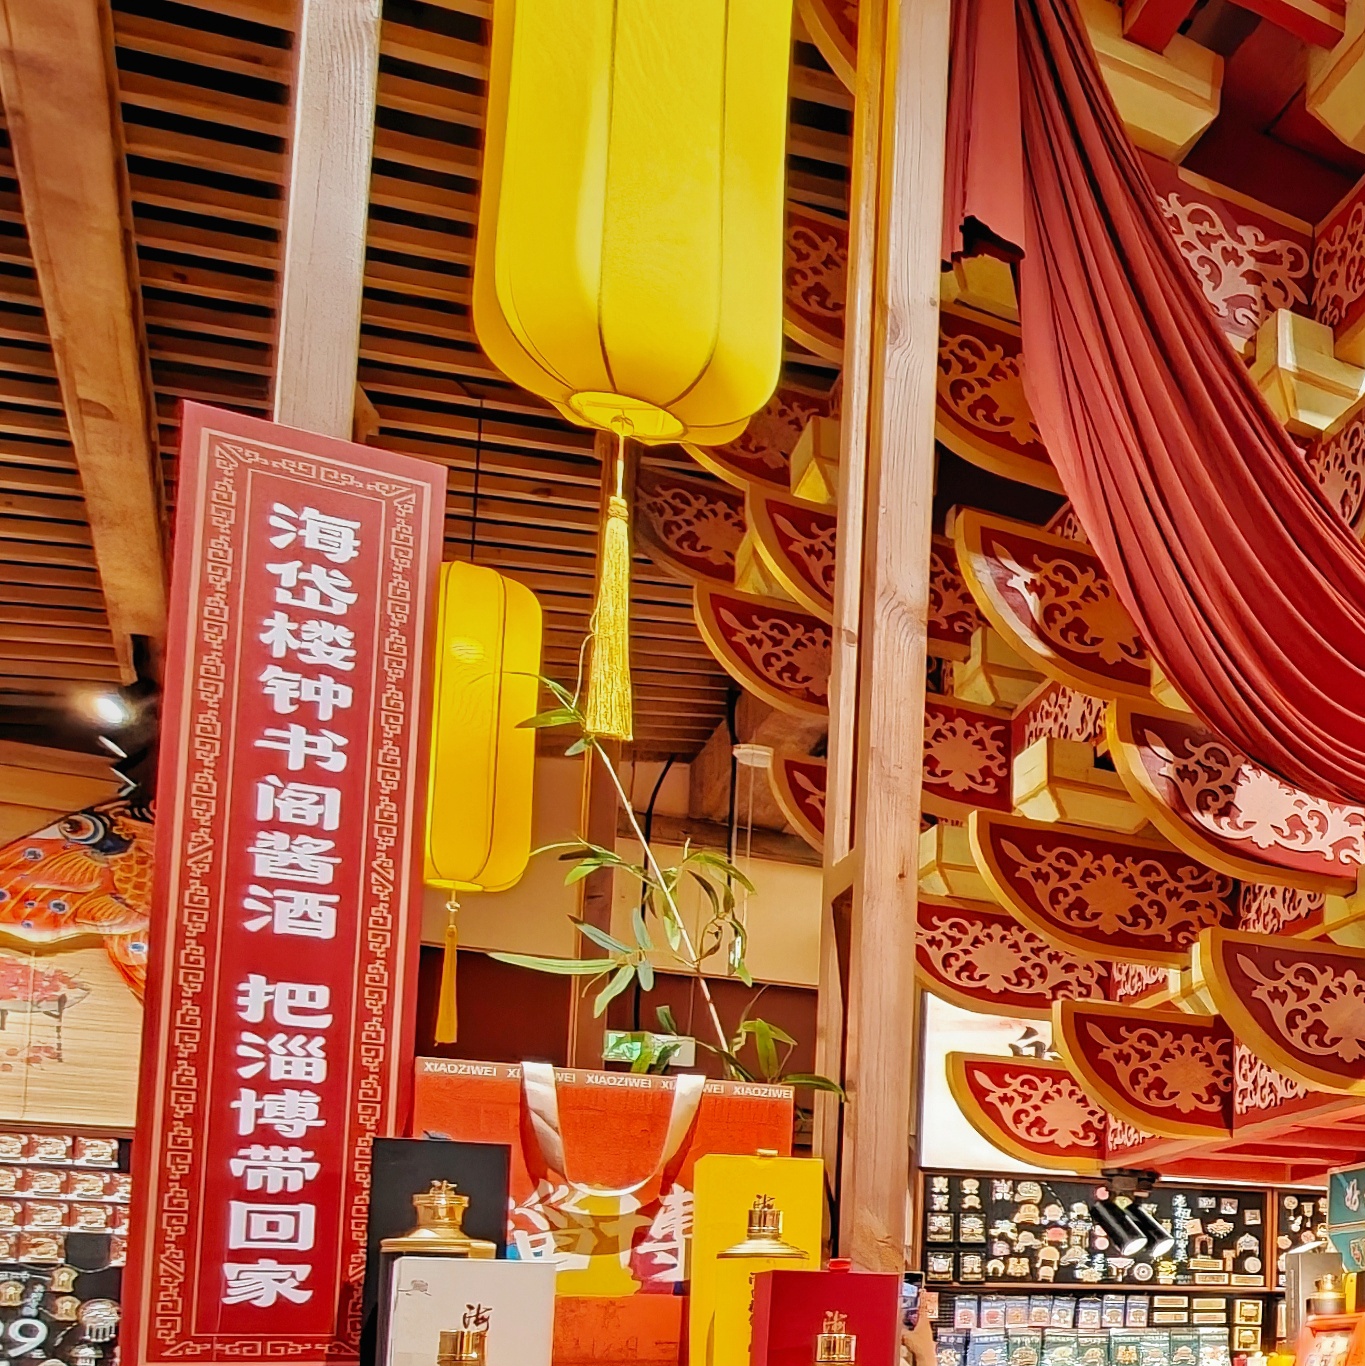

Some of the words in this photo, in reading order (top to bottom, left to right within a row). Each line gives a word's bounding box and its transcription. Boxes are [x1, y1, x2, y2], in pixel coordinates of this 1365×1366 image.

[242, 502, 362, 941] 海岱楼钟书阁酱酒
[221, 974, 332, 1309] 把淄博带回家
[423, 1060, 497, 1078] XIAOZIWEI
[585, 1073, 652, 1090] XIAOZIWEI
[732, 1085, 794, 1100] XIAOZIWEI
